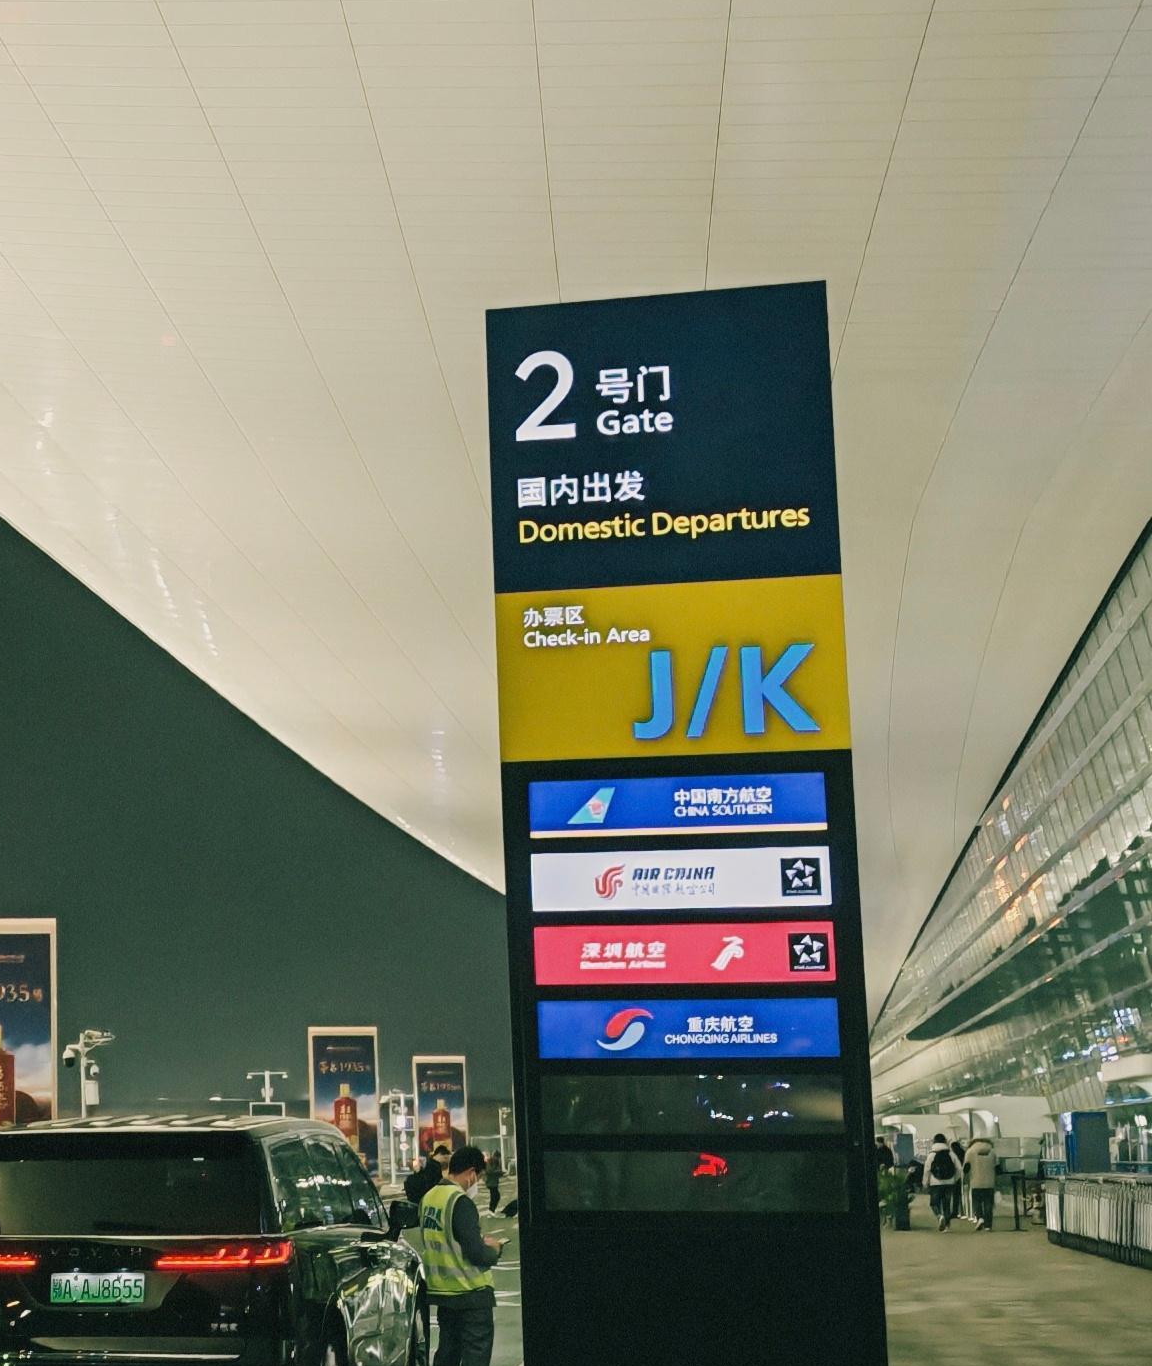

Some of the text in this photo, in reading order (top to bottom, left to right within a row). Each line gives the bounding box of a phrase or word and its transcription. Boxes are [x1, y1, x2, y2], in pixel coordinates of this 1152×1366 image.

[596, 365, 671, 404] 号门
[514, 350, 577, 442] 2
[596, 408, 674, 436] Gate
[517, 470, 646, 508] 国内出发
[518, 506, 810, 544] Domestic Departures
[523, 605, 585, 628] 办票区
[523, 627, 650, 649] Check-in Area
[633, 643, 821, 740] J/K
[674, 786, 772, 805] 中国南方航空
[674, 803, 773, 817] CHINA SOUTHERN
[632, 866, 715, 881] AIR CHINA
[580, 941, 666, 959] 深圳航空
[686, 1016, 755, 1033] 重庆航空
[664, 1033, 778, 1045] CHONGQING AIRLINES
